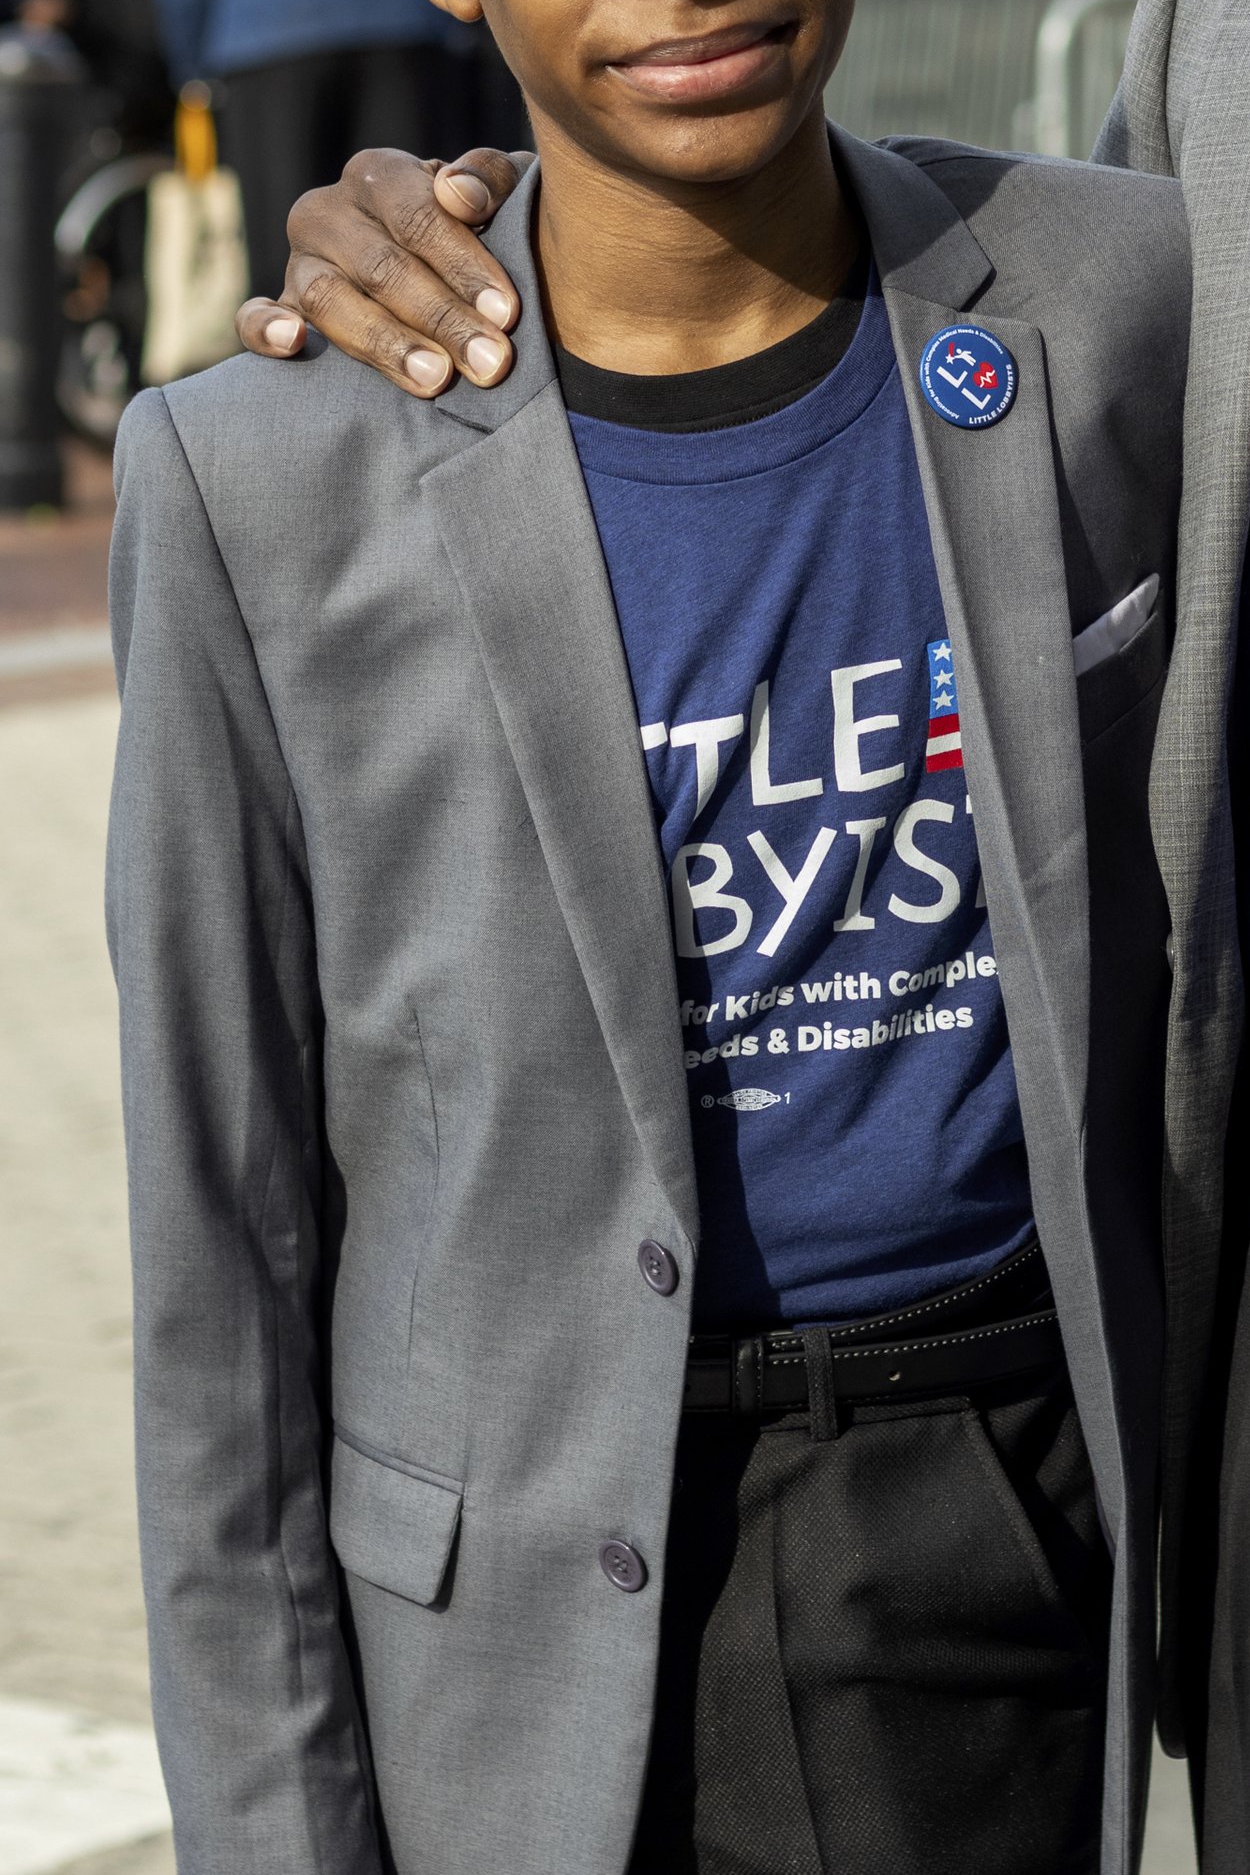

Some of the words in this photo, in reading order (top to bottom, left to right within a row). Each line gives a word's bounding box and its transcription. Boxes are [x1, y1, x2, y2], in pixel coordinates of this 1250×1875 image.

[968, 410, 997, 424] LITTLE
[996, 364, 1014, 413] LOBBYISTS
[671, 794, 988, 959] BYIS
[680, 999, 719, 1026] for
[725, 984, 795, 1021] Kids
[800, 971, 881, 1003] with
[888, 951, 999, 997] Comple
[767, 1027, 790, 1055] &
[798, 1004, 974, 1052] Disabilities
